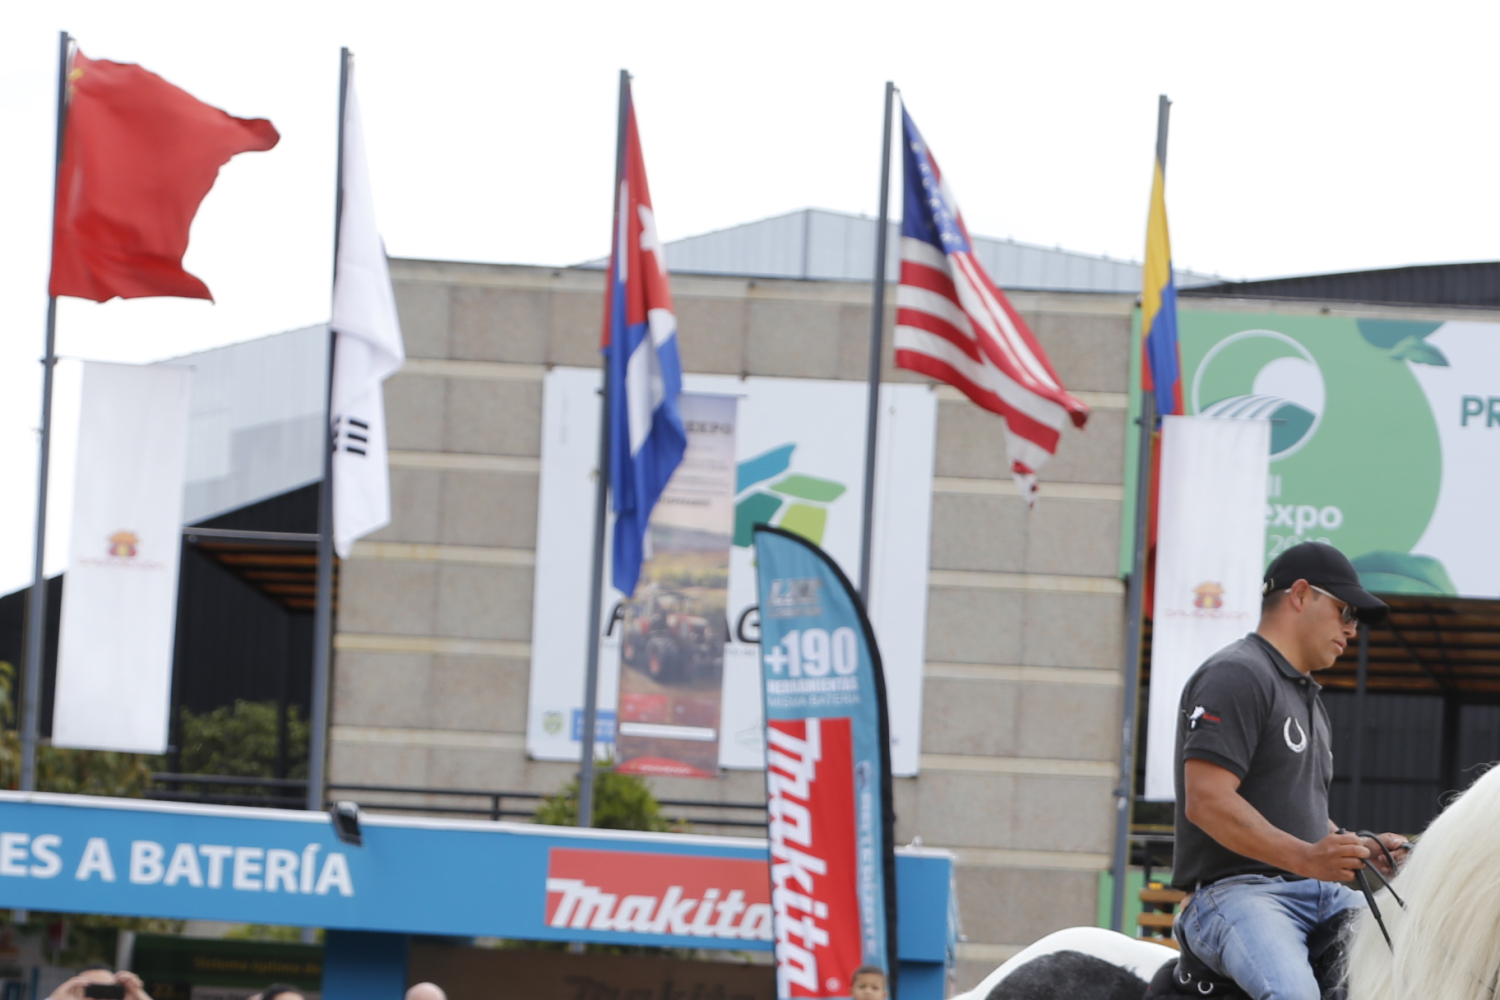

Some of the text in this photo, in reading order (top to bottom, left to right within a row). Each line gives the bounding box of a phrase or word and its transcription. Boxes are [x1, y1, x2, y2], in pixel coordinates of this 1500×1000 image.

[764, 627, 857, 678] +190
[75, 837, 117, 883] A
[129, 842, 355, 897] BATERÍA
